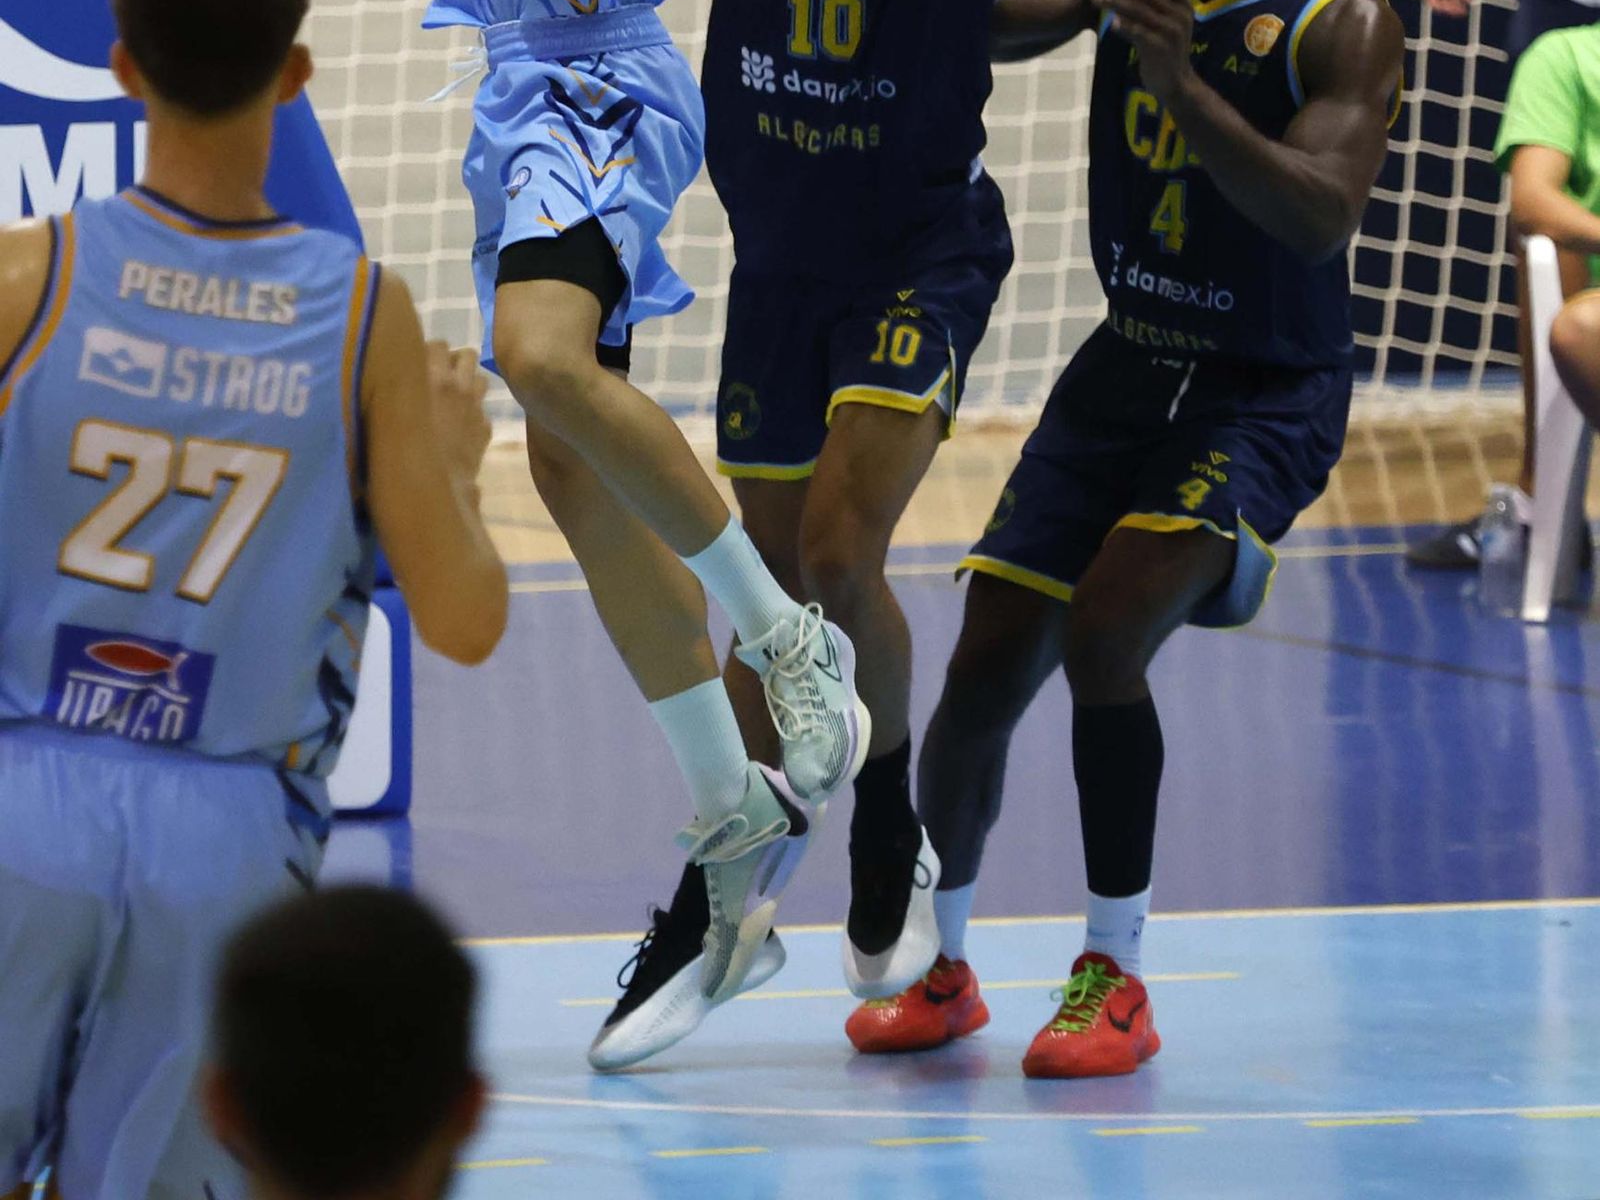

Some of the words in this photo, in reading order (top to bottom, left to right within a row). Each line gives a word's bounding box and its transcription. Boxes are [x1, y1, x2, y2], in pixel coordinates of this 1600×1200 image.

[1150, 178, 1188, 255] 4
[118, 260, 297, 325] PERALES
[869, 320, 922, 366] 10
[169, 349, 313, 418] STROG
[57, 417, 291, 606] 27
